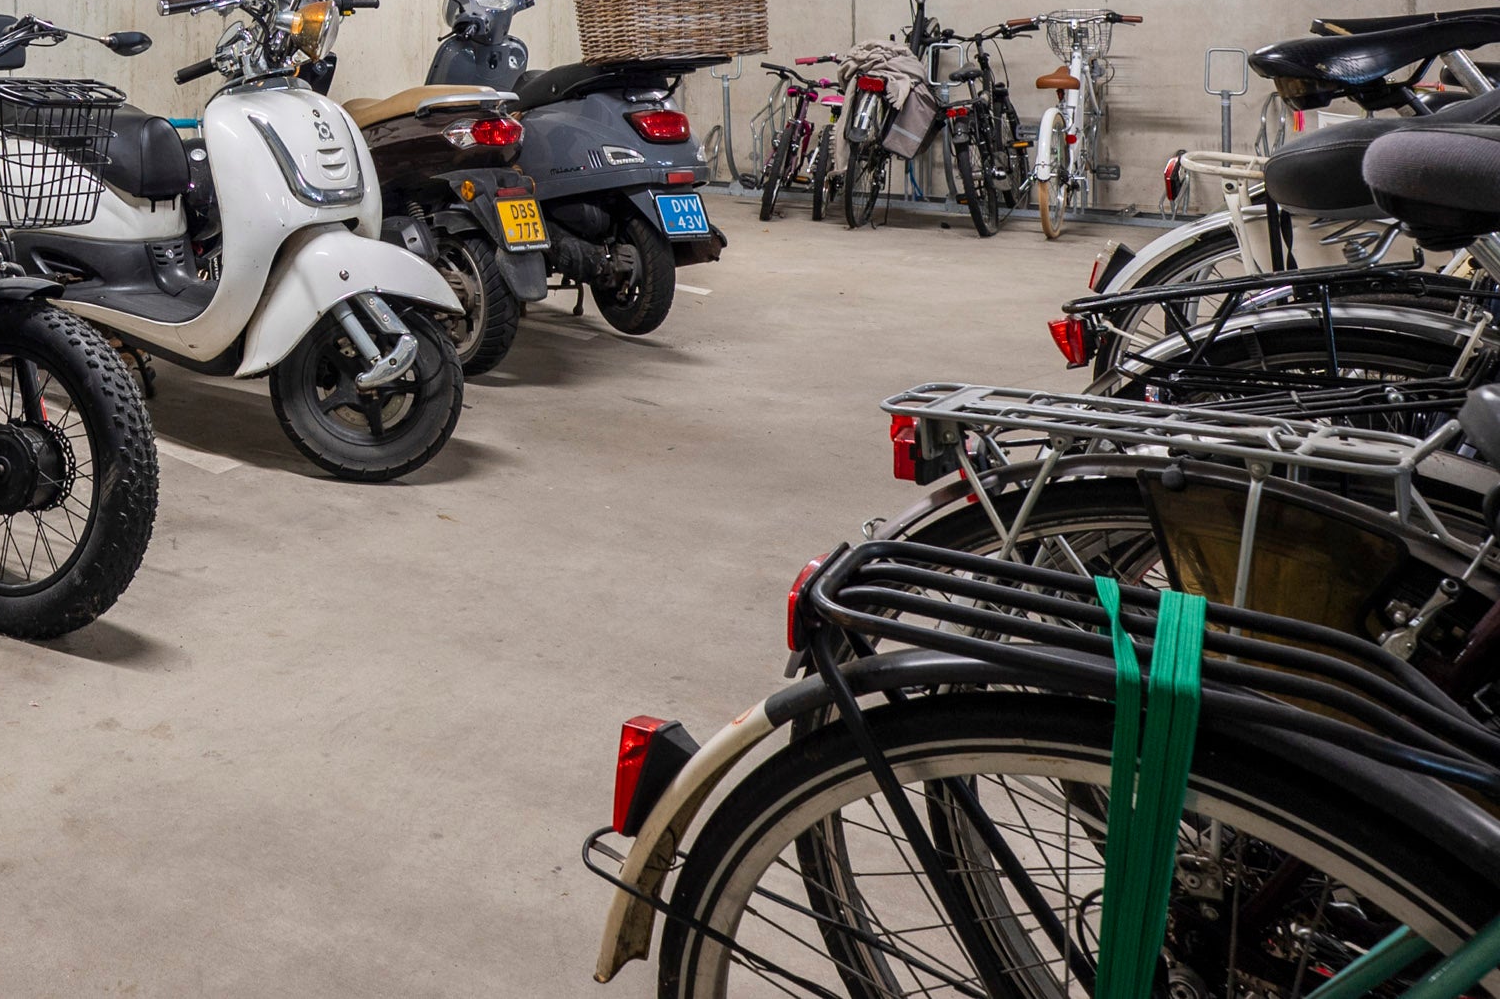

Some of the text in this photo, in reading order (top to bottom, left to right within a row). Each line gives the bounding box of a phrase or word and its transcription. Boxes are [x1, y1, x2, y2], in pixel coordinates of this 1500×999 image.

[510, 202, 536, 220] DBS
[671, 198, 697, 213] DVV
[678, 214, 703, 229] 43V
[516, 221, 540, 239] 77F
